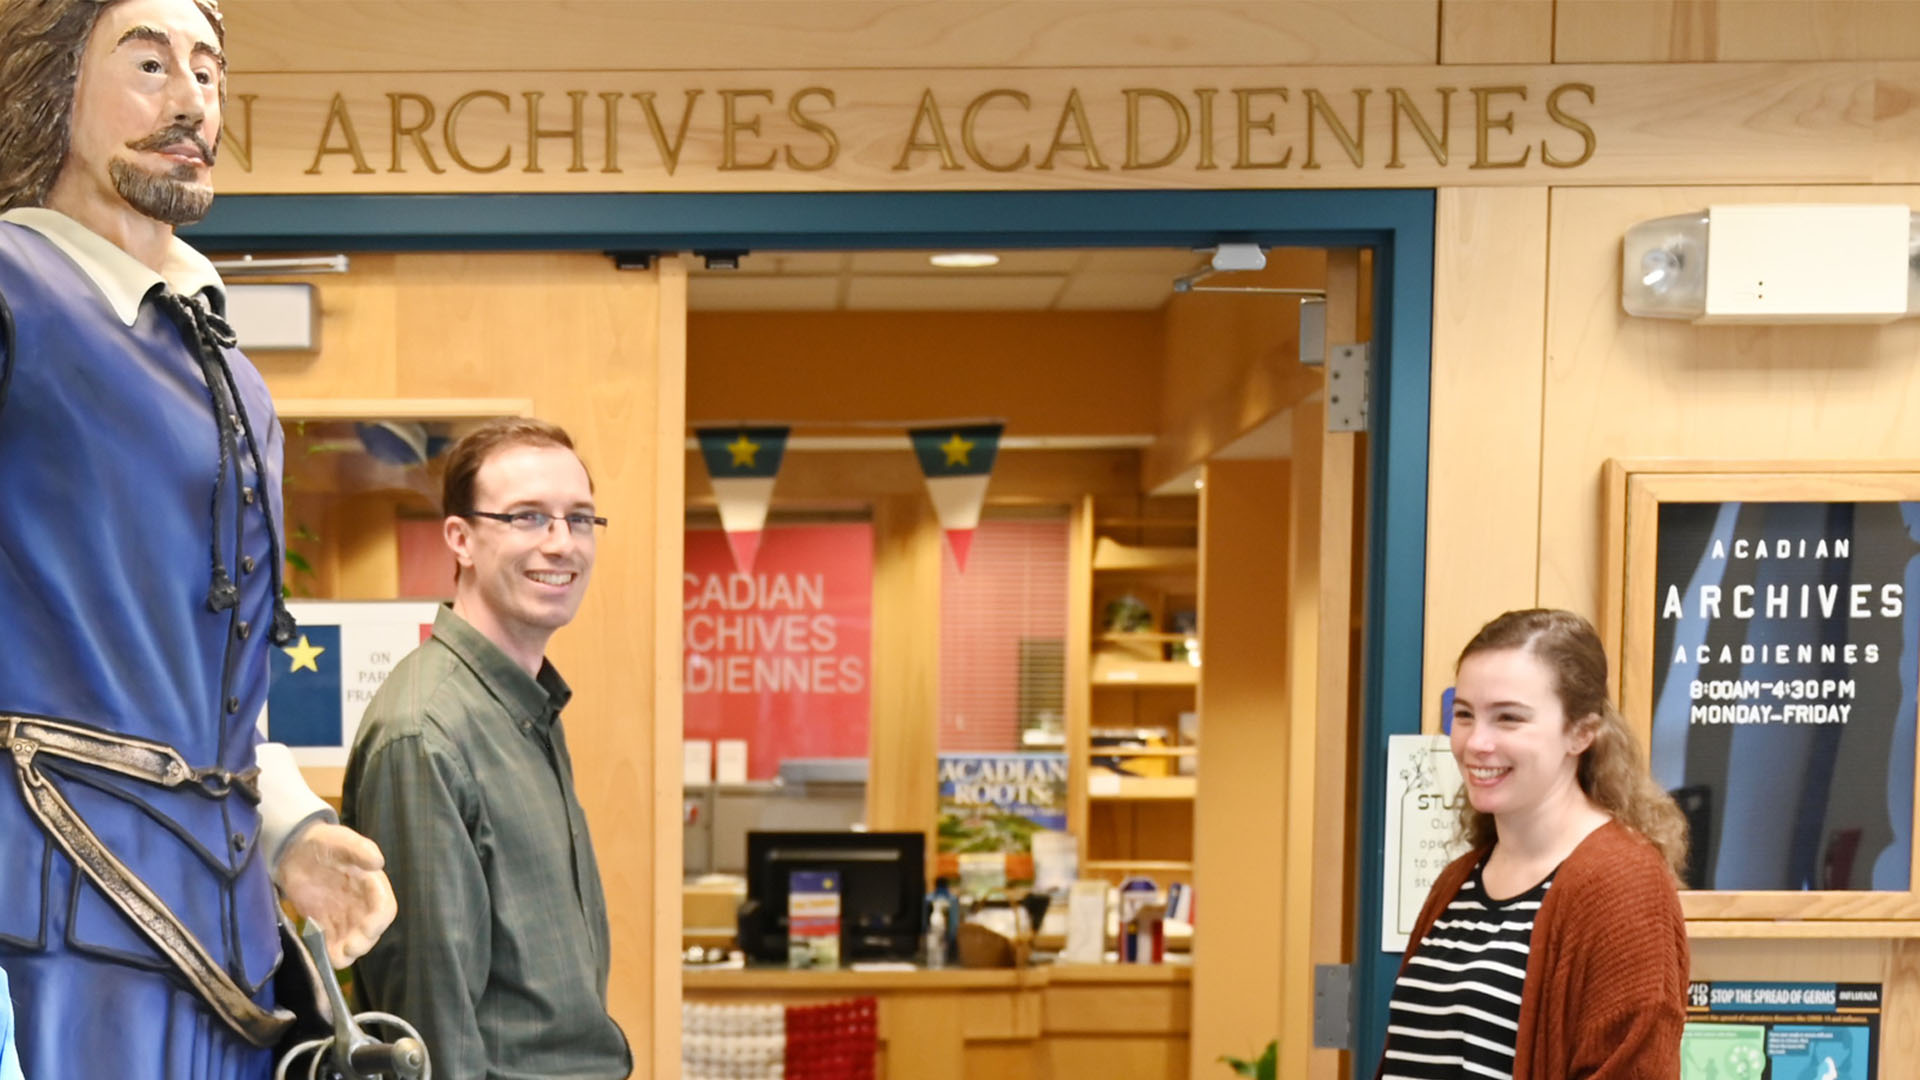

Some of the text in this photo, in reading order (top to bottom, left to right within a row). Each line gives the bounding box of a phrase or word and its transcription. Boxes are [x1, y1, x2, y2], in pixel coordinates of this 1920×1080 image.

[304, 87, 840, 177] ARCHIVES
[892, 82, 1598, 174] ACADIENNES
[1711, 538, 1850, 559] ACADIAN
[1662, 583, 1904, 619] ARCHIVES
[684, 614, 838, 652] CHIVES
[369, 652, 391, 665] ON
[1674, 644, 1880, 664] ACADIENNES
[684, 655, 864, 694] DIENNES
[1690, 704, 1852, 725] MONDAY-FRIDAY
[938, 759, 1067, 782] ACADIAN
[954, 783, 1054, 805] ROOTS
[1414, 858, 1428, 868] to
[1691, 994, 1709, 1007] 19
[1710, 988, 1836, 1005] STOP THE SPREAD OF GERMS
